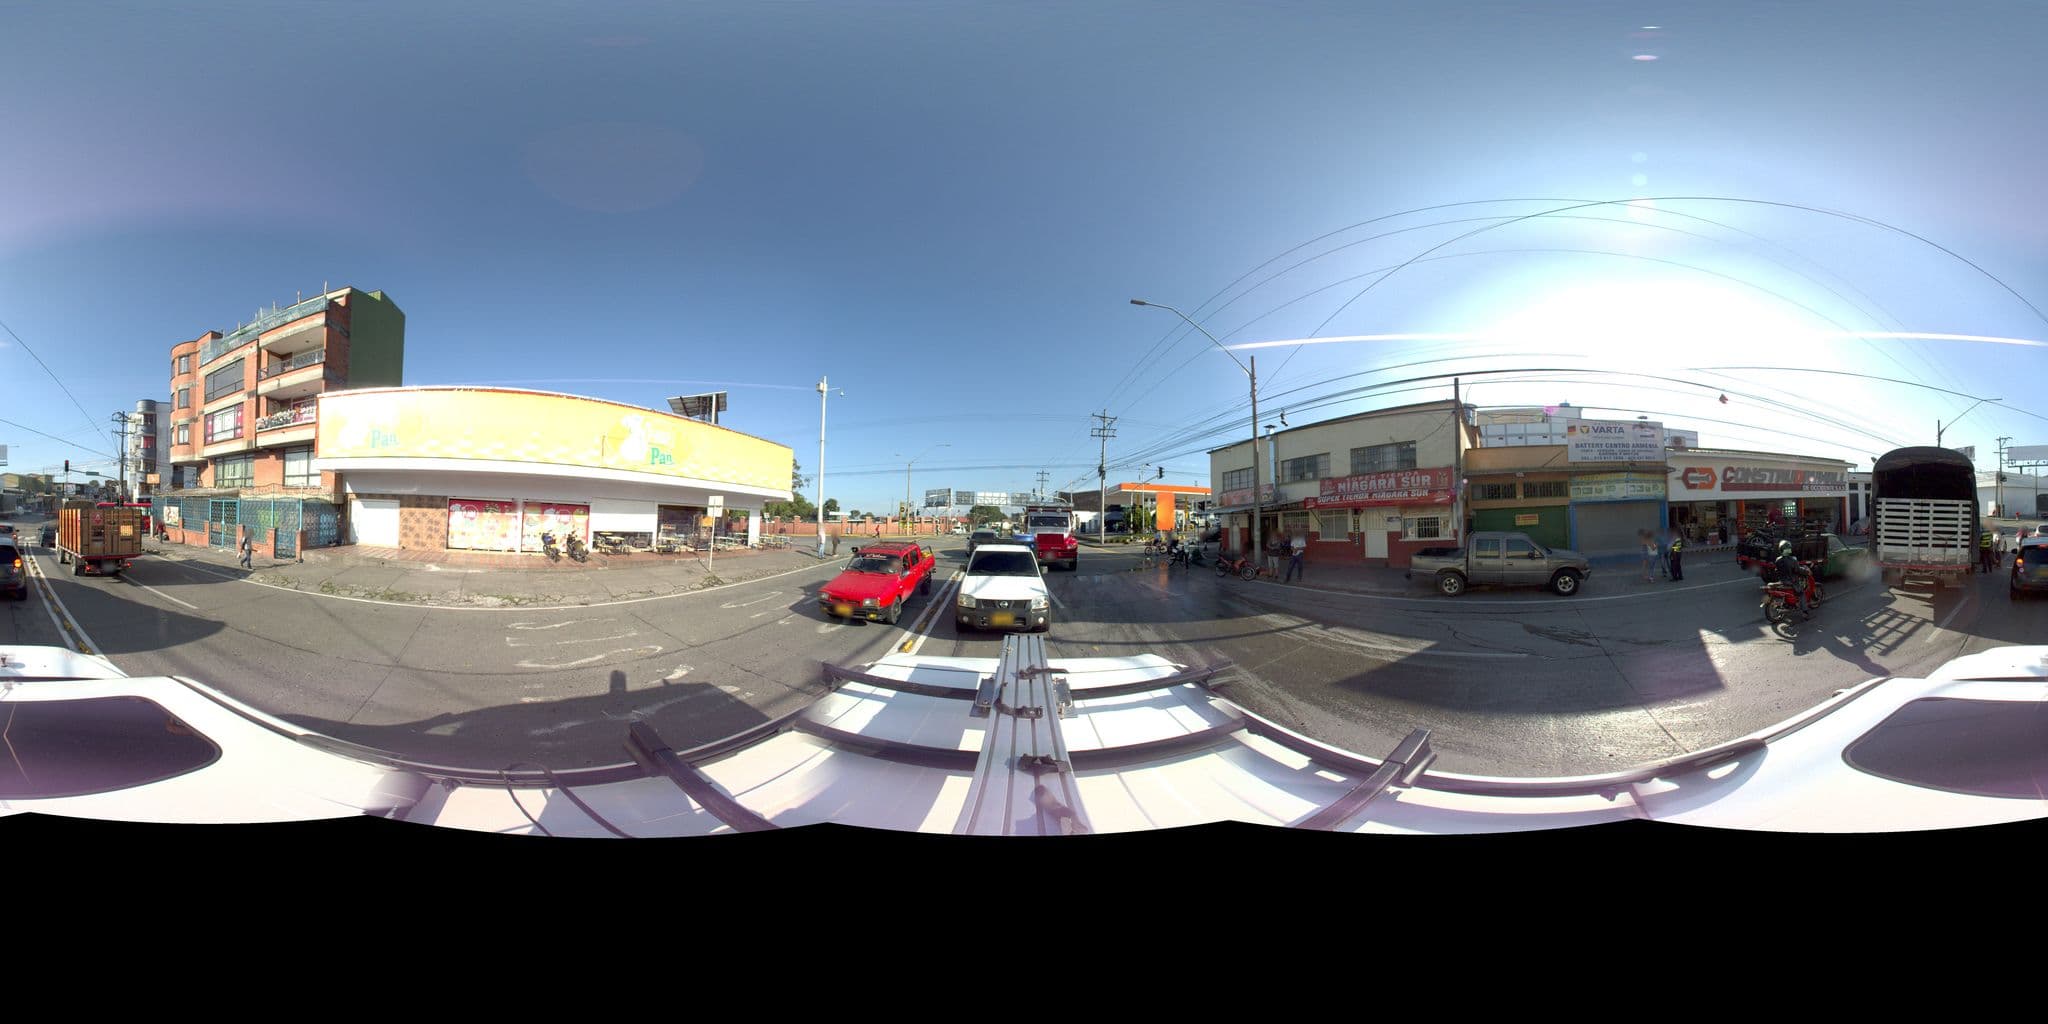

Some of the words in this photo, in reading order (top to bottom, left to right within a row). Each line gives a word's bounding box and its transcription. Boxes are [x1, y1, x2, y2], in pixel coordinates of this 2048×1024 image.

[650, 447, 673, 465] Pan
[1338, 478, 1396, 492] NIAGARA
[1402, 474, 1432, 487] SUR
[1342, 492, 1369, 501] TIENDA
[1372, 491, 1408, 499] NIAGARA
[1411, 489, 1429, 497] SUR
